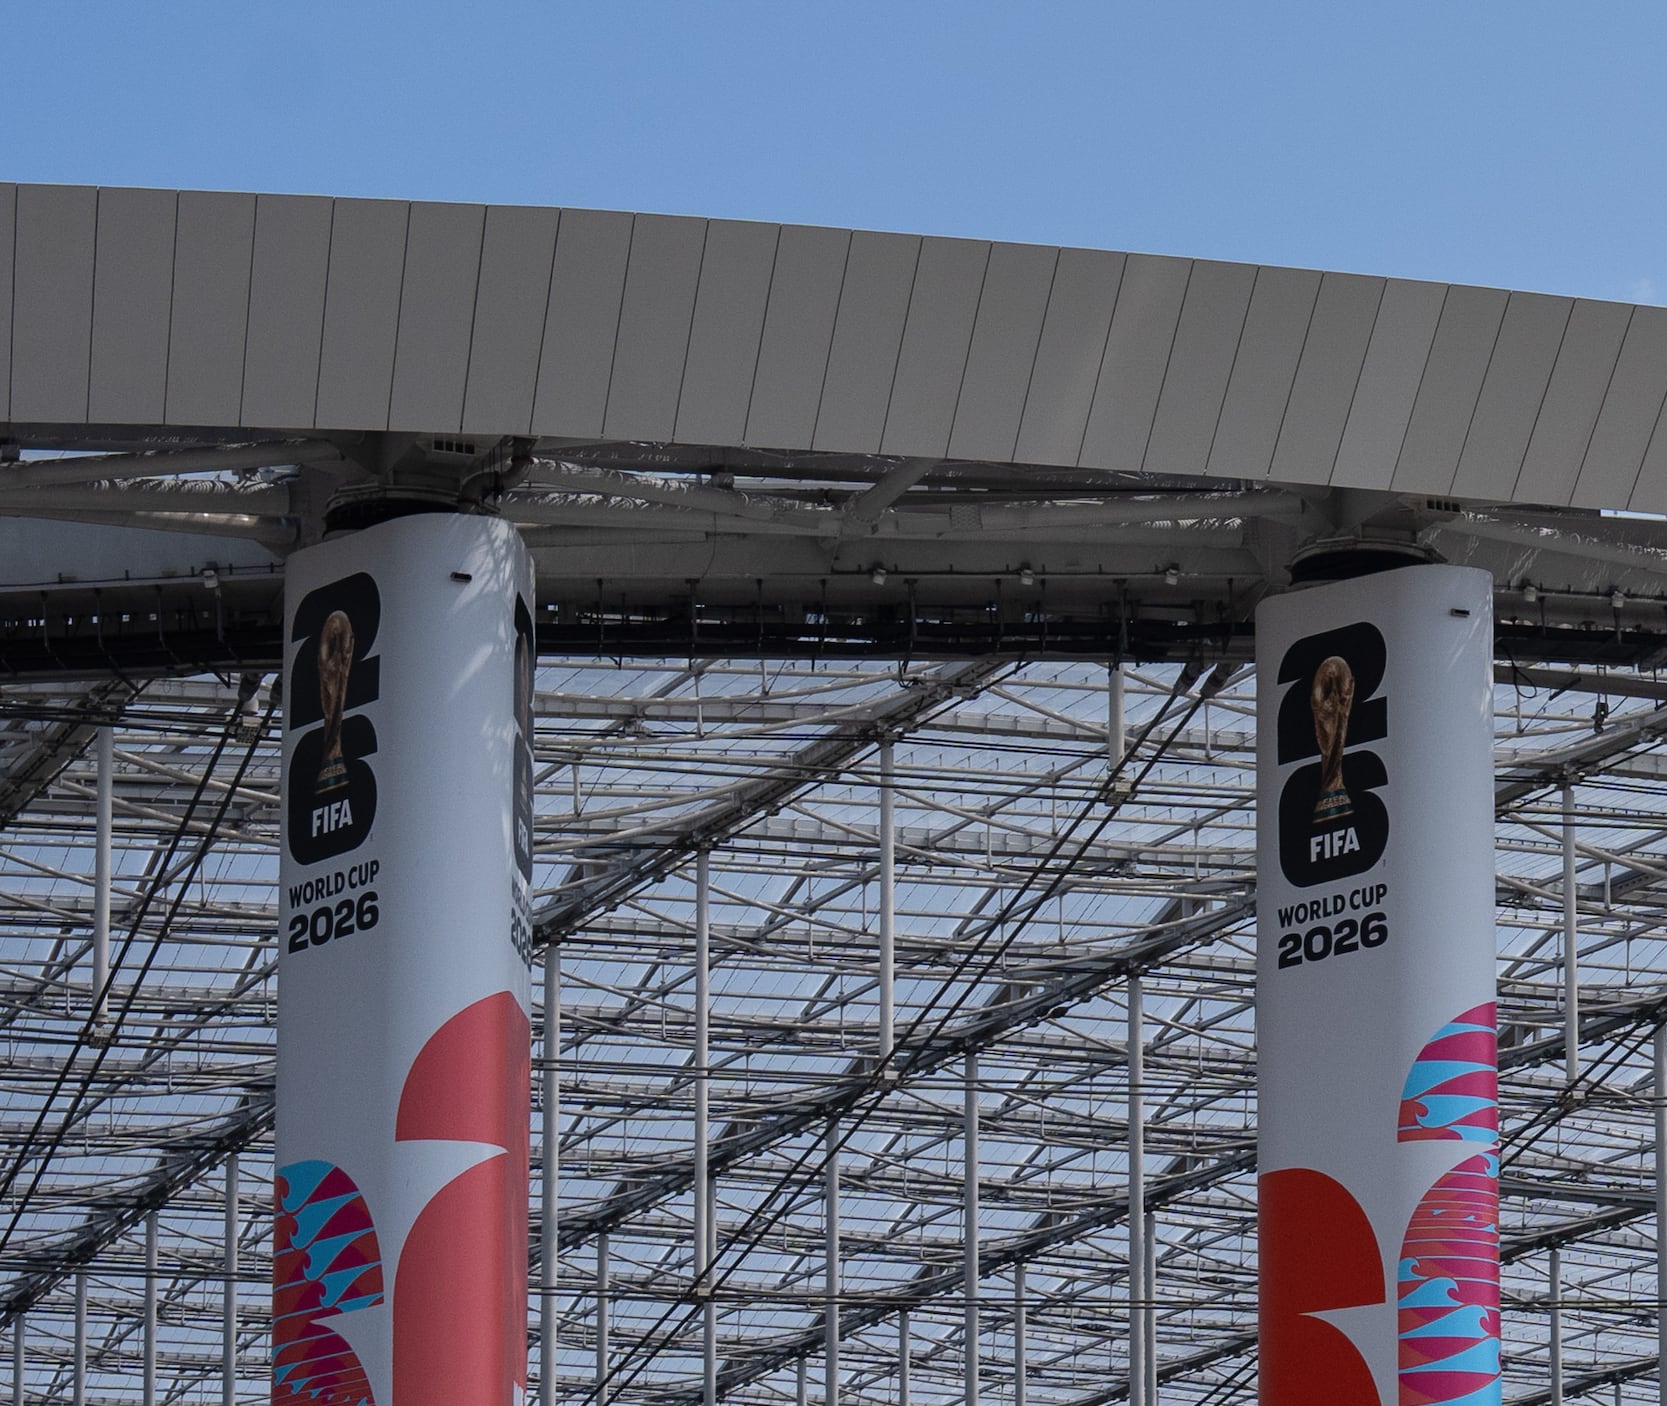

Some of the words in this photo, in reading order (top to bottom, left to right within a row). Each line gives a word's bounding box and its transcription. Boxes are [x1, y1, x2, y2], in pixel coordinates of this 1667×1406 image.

[311, 799, 353, 838] FIFA
[1310, 827, 1360, 862] FIFA
[289, 871, 345, 909] WORLD
[348, 859, 379, 887] CUP
[1278, 895, 1345, 928] WORLD
[1349, 884, 1387, 910] CUP
[288, 891, 379, 954] 2026
[1278, 912, 1388, 969] 2026
